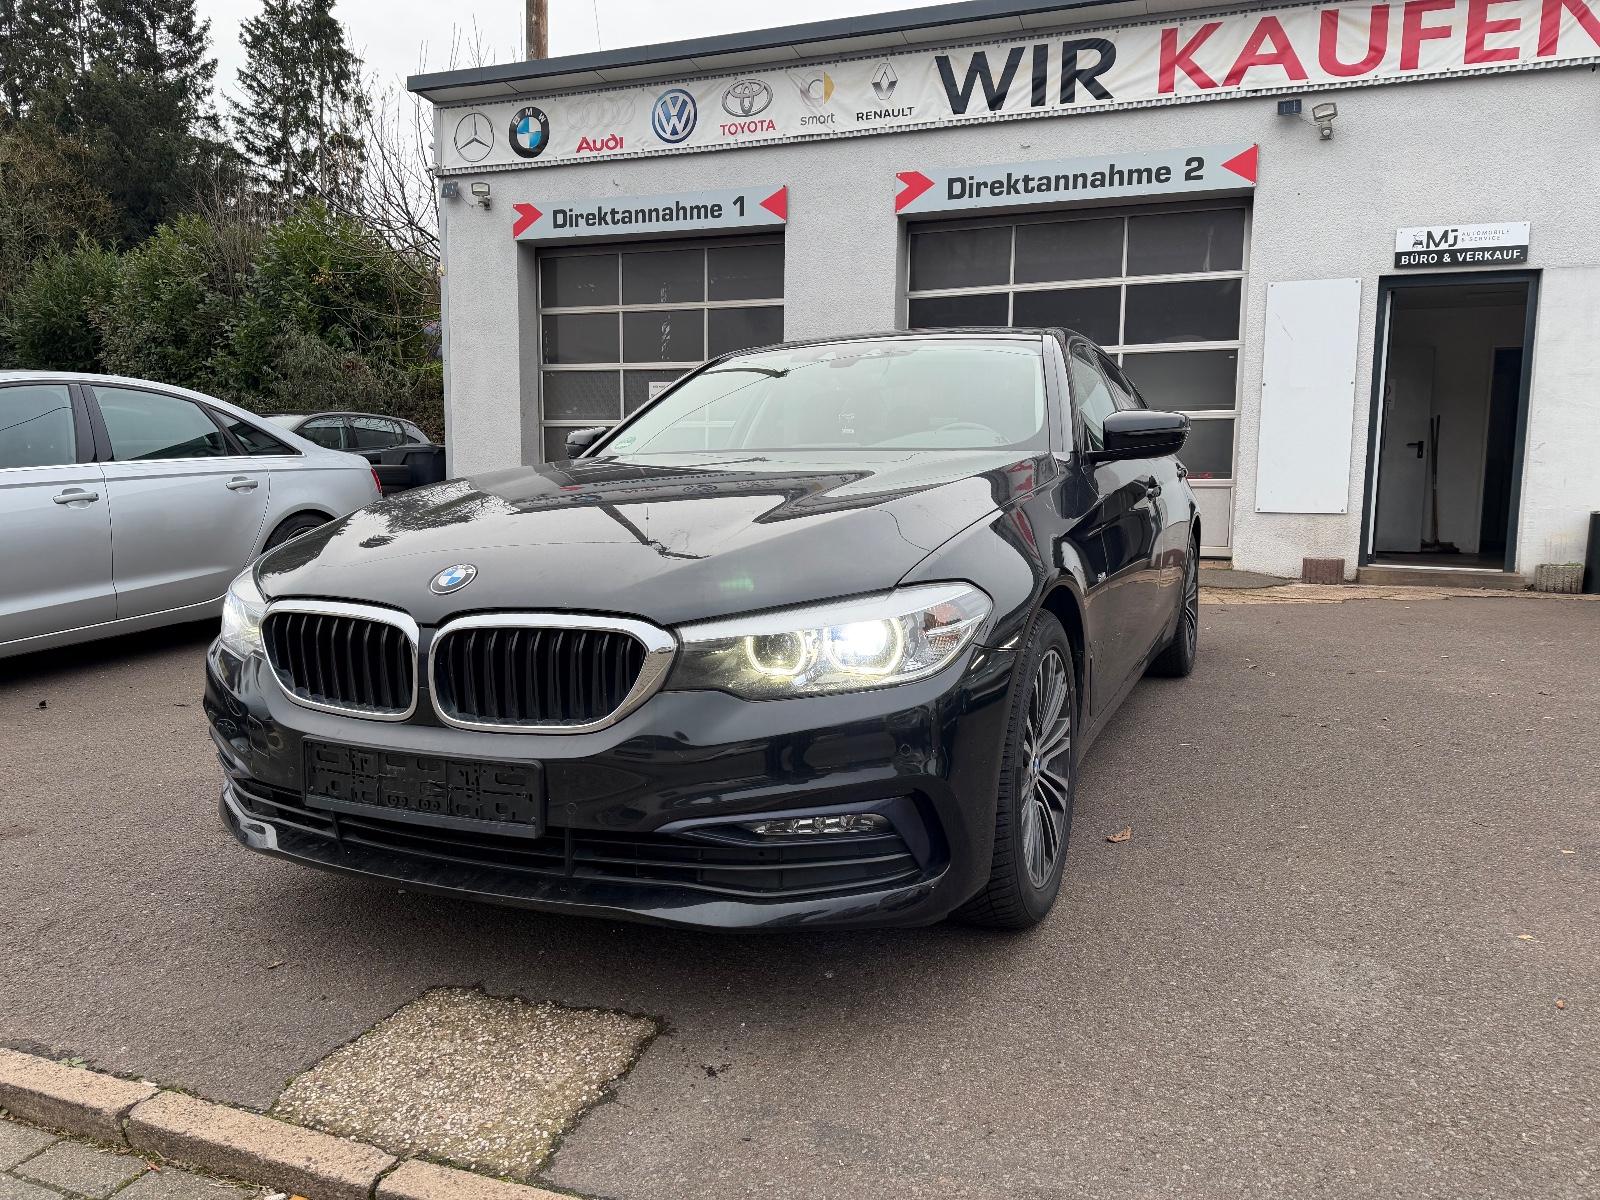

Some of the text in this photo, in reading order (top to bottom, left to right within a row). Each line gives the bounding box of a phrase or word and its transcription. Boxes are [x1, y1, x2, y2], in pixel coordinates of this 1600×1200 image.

[935, 38, 1116, 115] WIR
[800, 112, 836, 126] smart
[856, 106, 915, 122] RENAULT
[719, 119, 777, 136] TOYOTA
[575, 133, 624, 153] Audi
[947, 156, 1205, 200] Direktannahme 2
[552, 195, 745, 229] Direktannahme 1
[1401, 249, 1521, 265] BÜRO & VERKAUF
